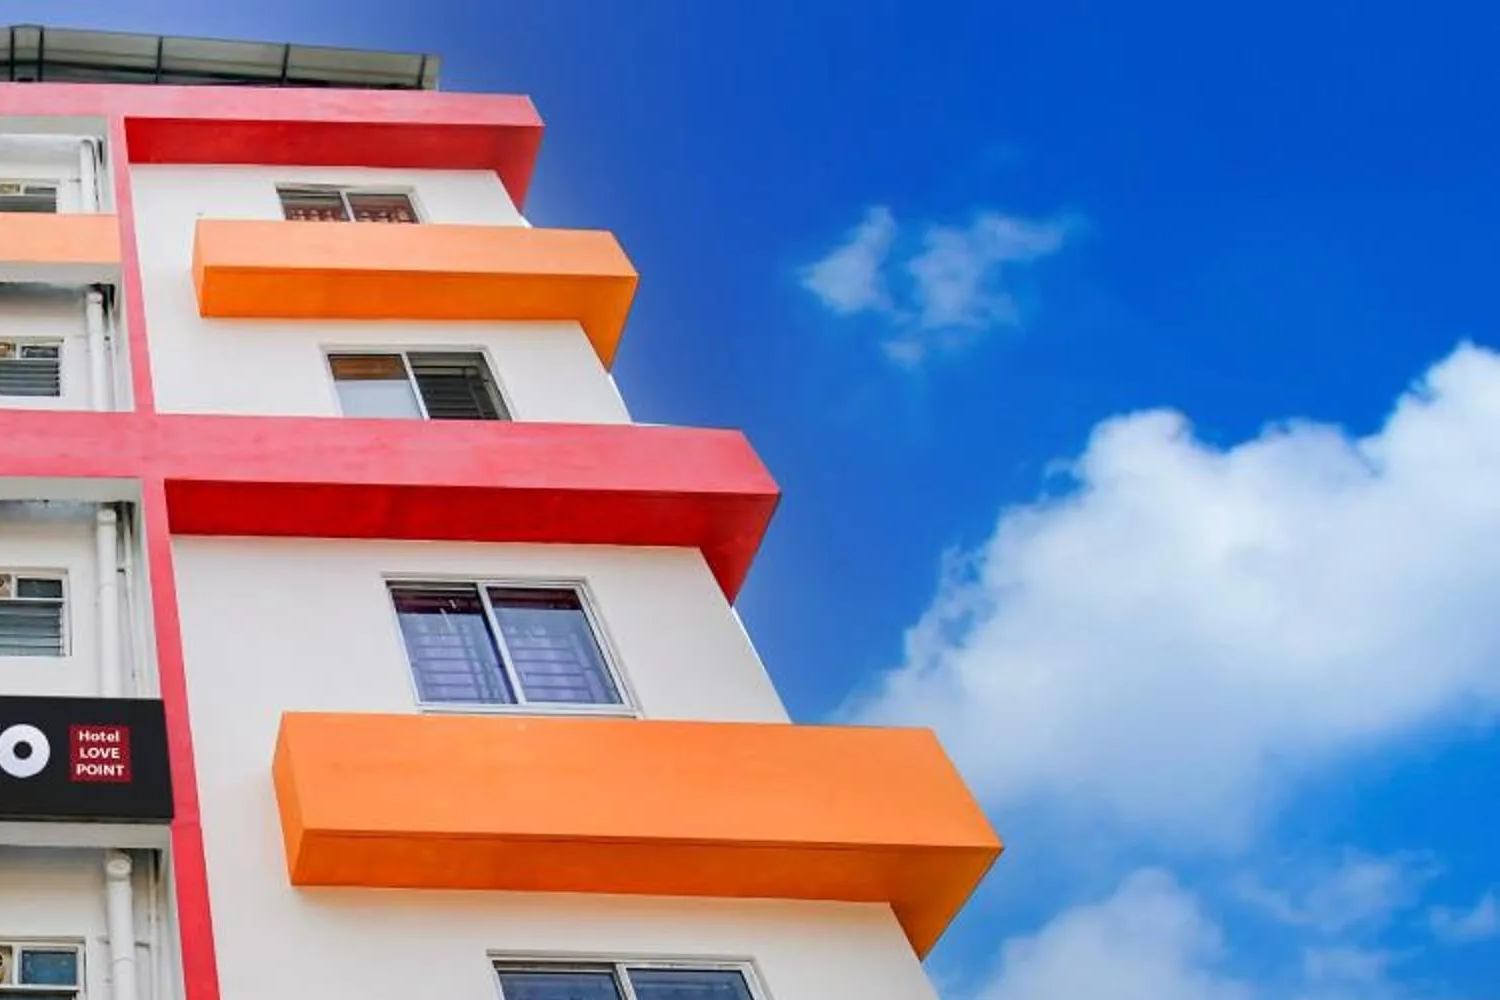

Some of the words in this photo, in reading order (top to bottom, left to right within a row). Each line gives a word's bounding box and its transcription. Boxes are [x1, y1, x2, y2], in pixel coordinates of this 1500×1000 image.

[79, 730, 120, 742] Hotel
[79, 747, 120, 759] LOVE
[76, 763, 125, 776] POINT
